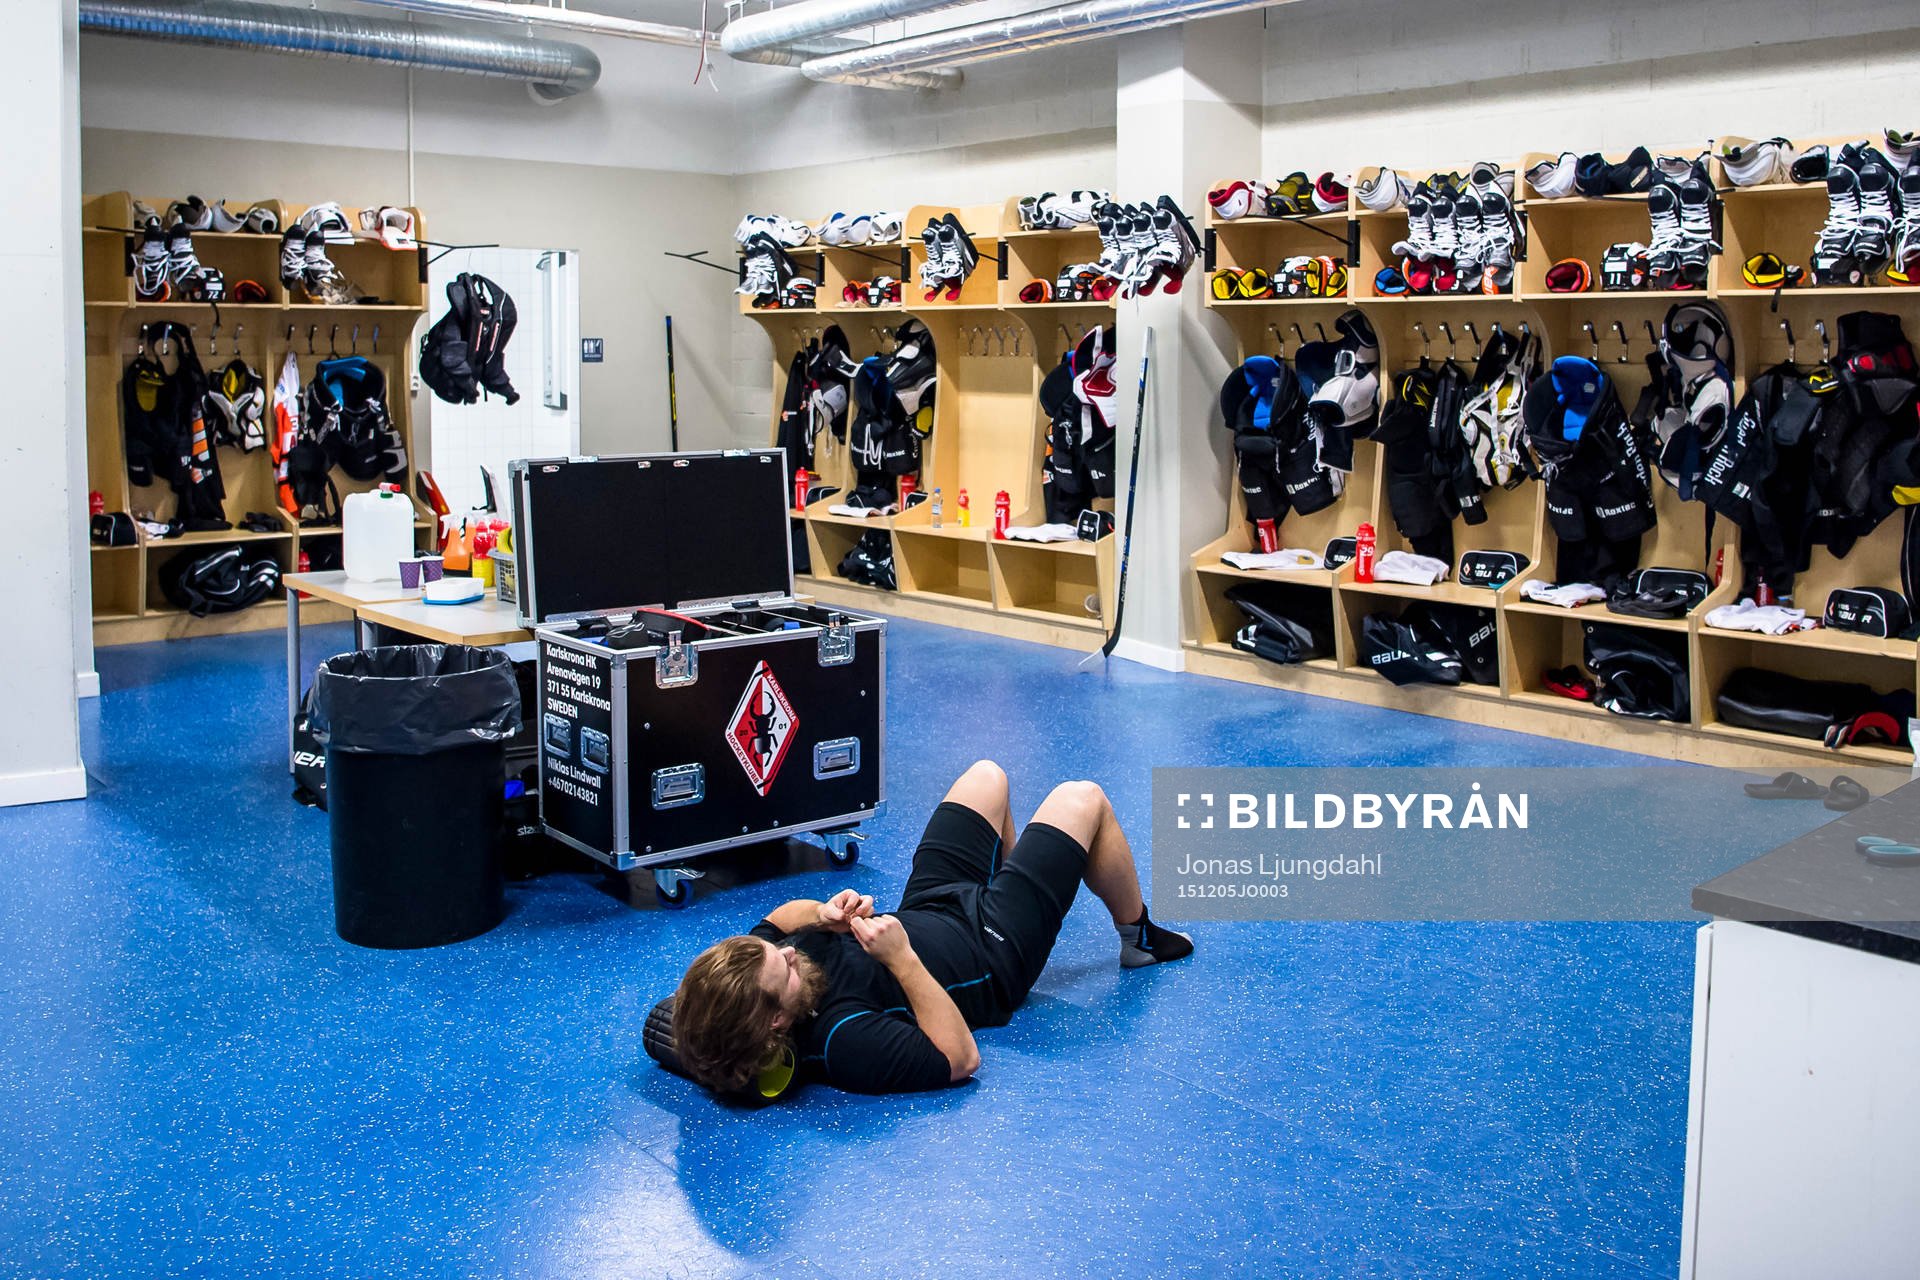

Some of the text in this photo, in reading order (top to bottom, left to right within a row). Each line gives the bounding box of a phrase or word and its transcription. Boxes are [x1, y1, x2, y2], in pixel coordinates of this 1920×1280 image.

[1704, 453, 1735, 485] Rock
[546, 643, 597, 669] Karlskrona HK
[1371, 650, 1418, 665] BAU
[546, 661, 601, 689] Arenavägen 19
[547, 679, 611, 711] 371 55 Karlskrona
[547, 697, 578, 719] SWEDEN
[766, 673, 797, 723] KARLSKRONA
[547, 756, 601, 789] Niklas Lindwall
[726, 731, 760, 785] HOCKEYKLUBB
